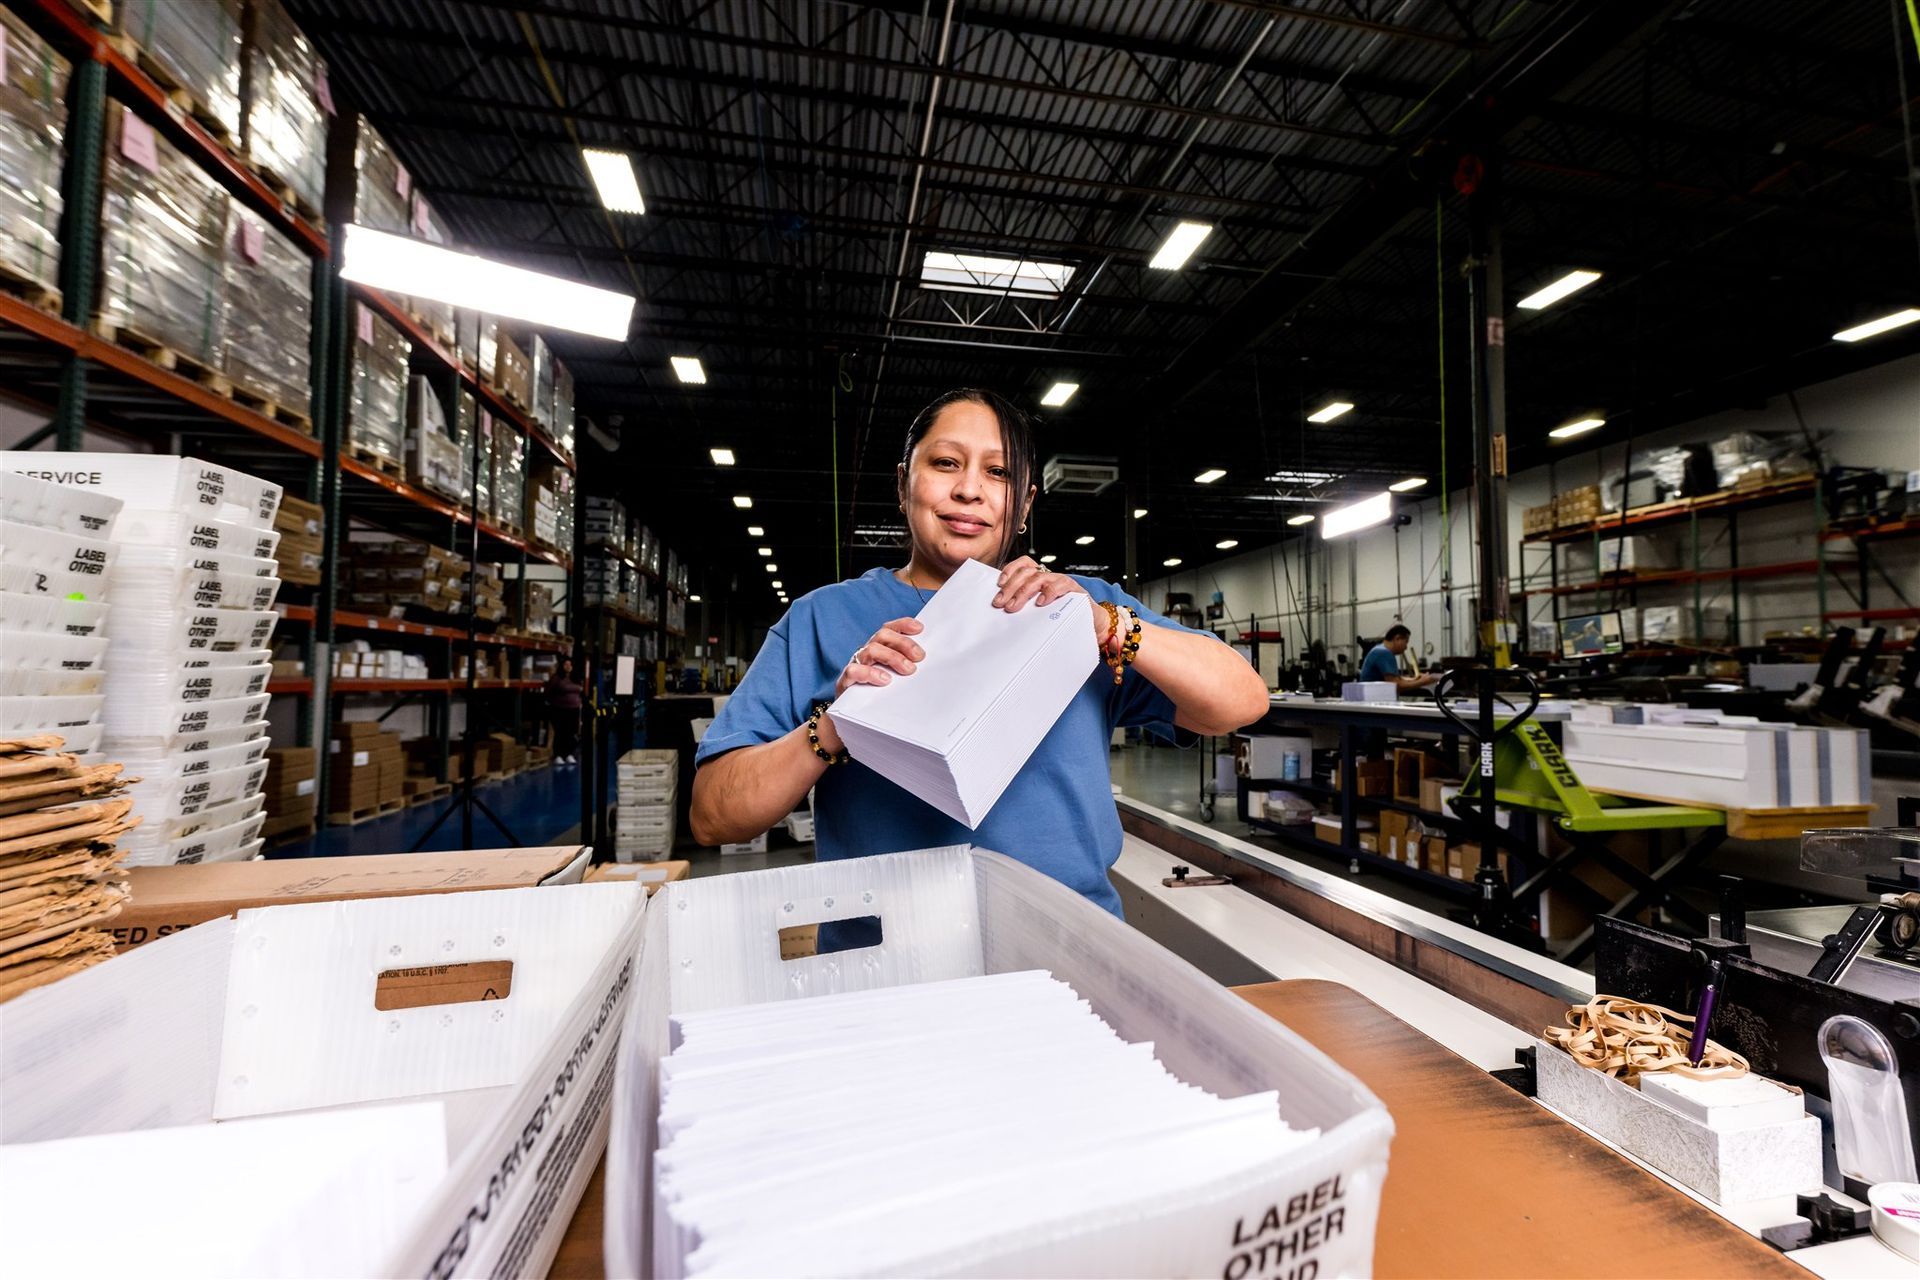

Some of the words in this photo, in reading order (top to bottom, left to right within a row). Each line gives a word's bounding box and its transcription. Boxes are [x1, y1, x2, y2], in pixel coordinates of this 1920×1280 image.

[15, 470, 102, 485] ERVICE
[200, 469, 225, 485] LABEL
[197, 481, 224, 496] OTHER
[200, 493, 217, 506] END
[193, 524, 219, 539] LABEL
[189, 535, 219, 550] OTHER
[75, 547, 107, 563] LABEL
[69, 560, 105, 575] OTHER
[193, 559, 219, 572] LABEL
[199, 580, 222, 592] LABEL
[194, 591, 221, 603] OTHER
[192, 616, 218, 627] LABEL
[188, 627, 217, 638] OTHER
[189, 638, 207, 648] END
[186, 677, 212, 688] LABEL
[182, 688, 211, 700] OTHER
[182, 710, 209, 722] LABEL
[178, 721, 207, 733] OTHER
[184, 740, 209, 752] LABEL
[1481, 741, 1494, 777] CLARK
[1526, 728, 1579, 788] CLARK
[183, 760, 209, 773] LABEL
[184, 781, 211, 794] LABEL
[180, 792, 208, 806] OTHER
[178, 843, 206, 859] LABEL
[1231, 1172, 1347, 1249] LABEL
[1222, 1206, 1347, 1280] OTHER
